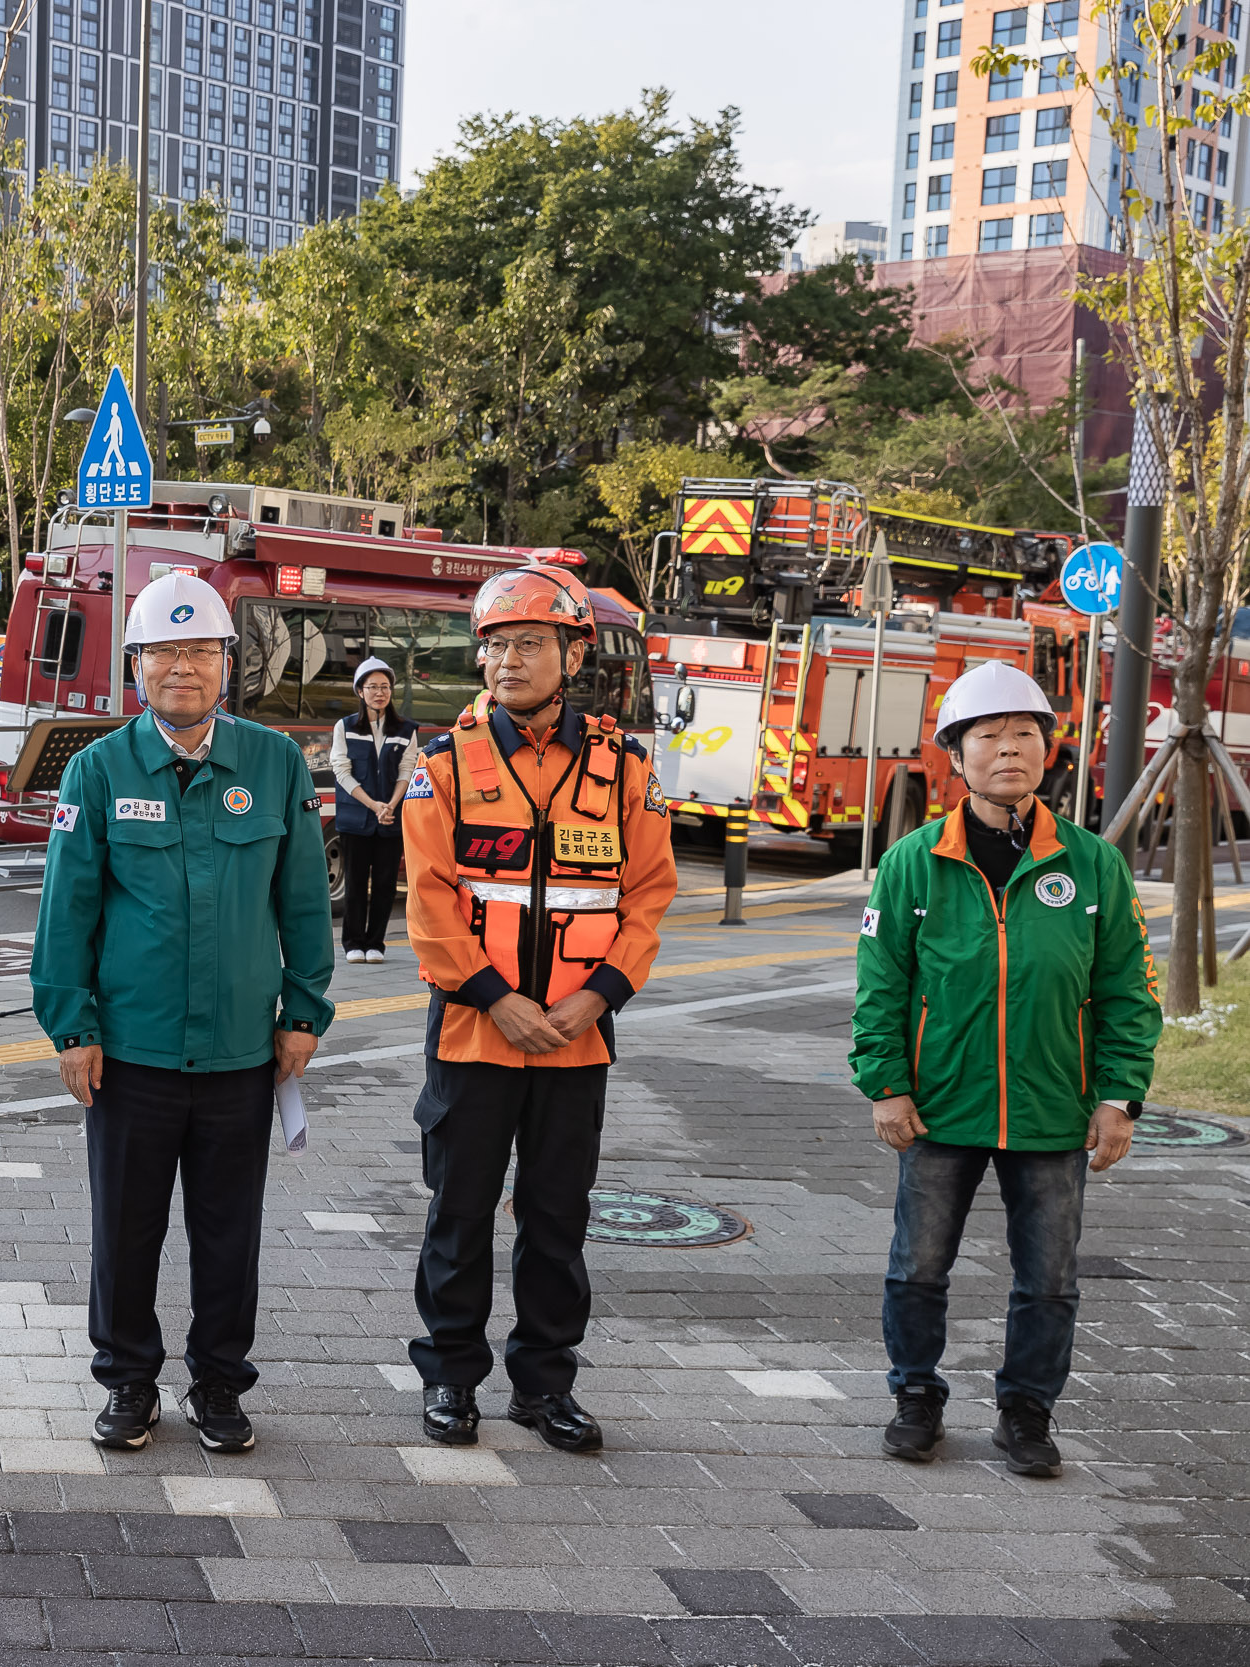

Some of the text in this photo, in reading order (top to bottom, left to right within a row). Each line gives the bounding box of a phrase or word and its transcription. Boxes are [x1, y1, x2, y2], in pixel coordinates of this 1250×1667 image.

[85, 482, 142, 504] 횡단보도
[446, 562, 479, 577] 광진소방서
[703, 576, 745, 596] 119
[667, 726, 733, 756] 119
[133, 810, 162, 819] 광진구청장
[559, 828, 613, 843] 긴급구조
[465, 830, 525, 860] 119
[559, 843, 614, 857] 통제단장
